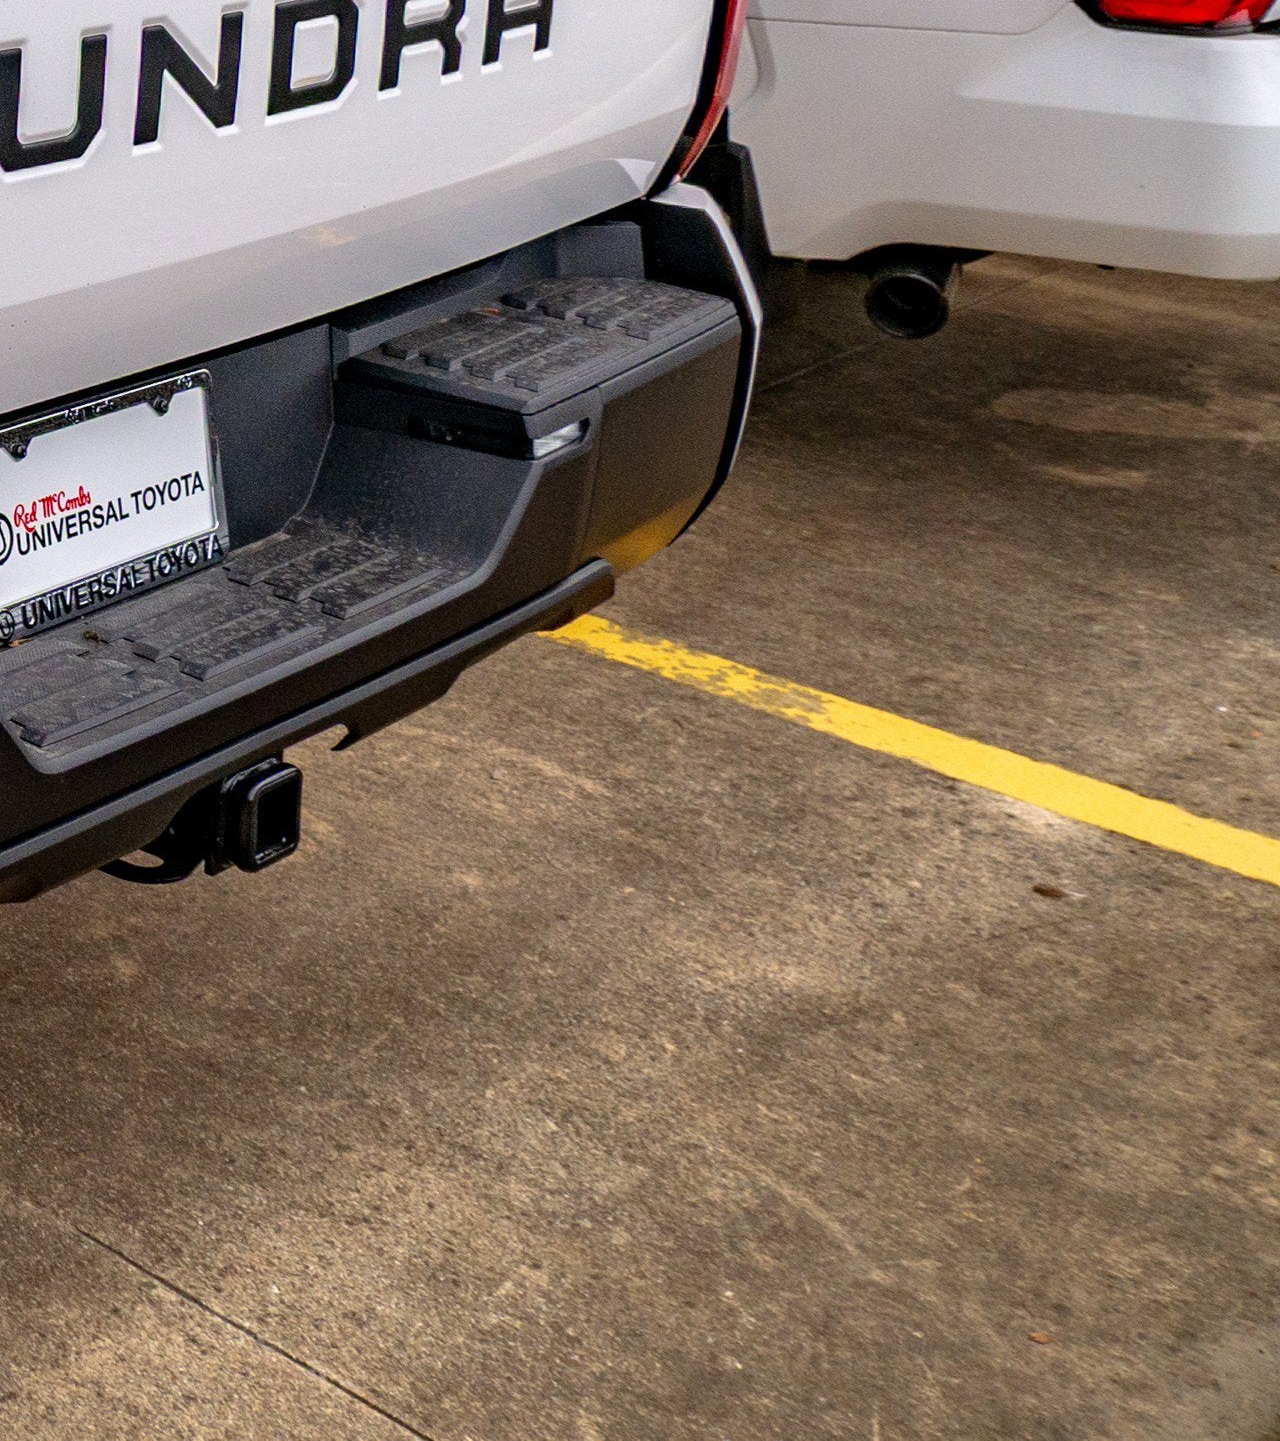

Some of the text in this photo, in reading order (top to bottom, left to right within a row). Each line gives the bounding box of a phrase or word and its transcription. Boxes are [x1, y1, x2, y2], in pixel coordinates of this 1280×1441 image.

[13, 485, 92, 533] Red McCombs
[15, 497, 130, 556] UNIVERSAL
[130, 470, 205, 515] TOYOTA
[20, 562, 143, 630] UNIVERSAL
[145, 532, 225, 583] TOYOTA
